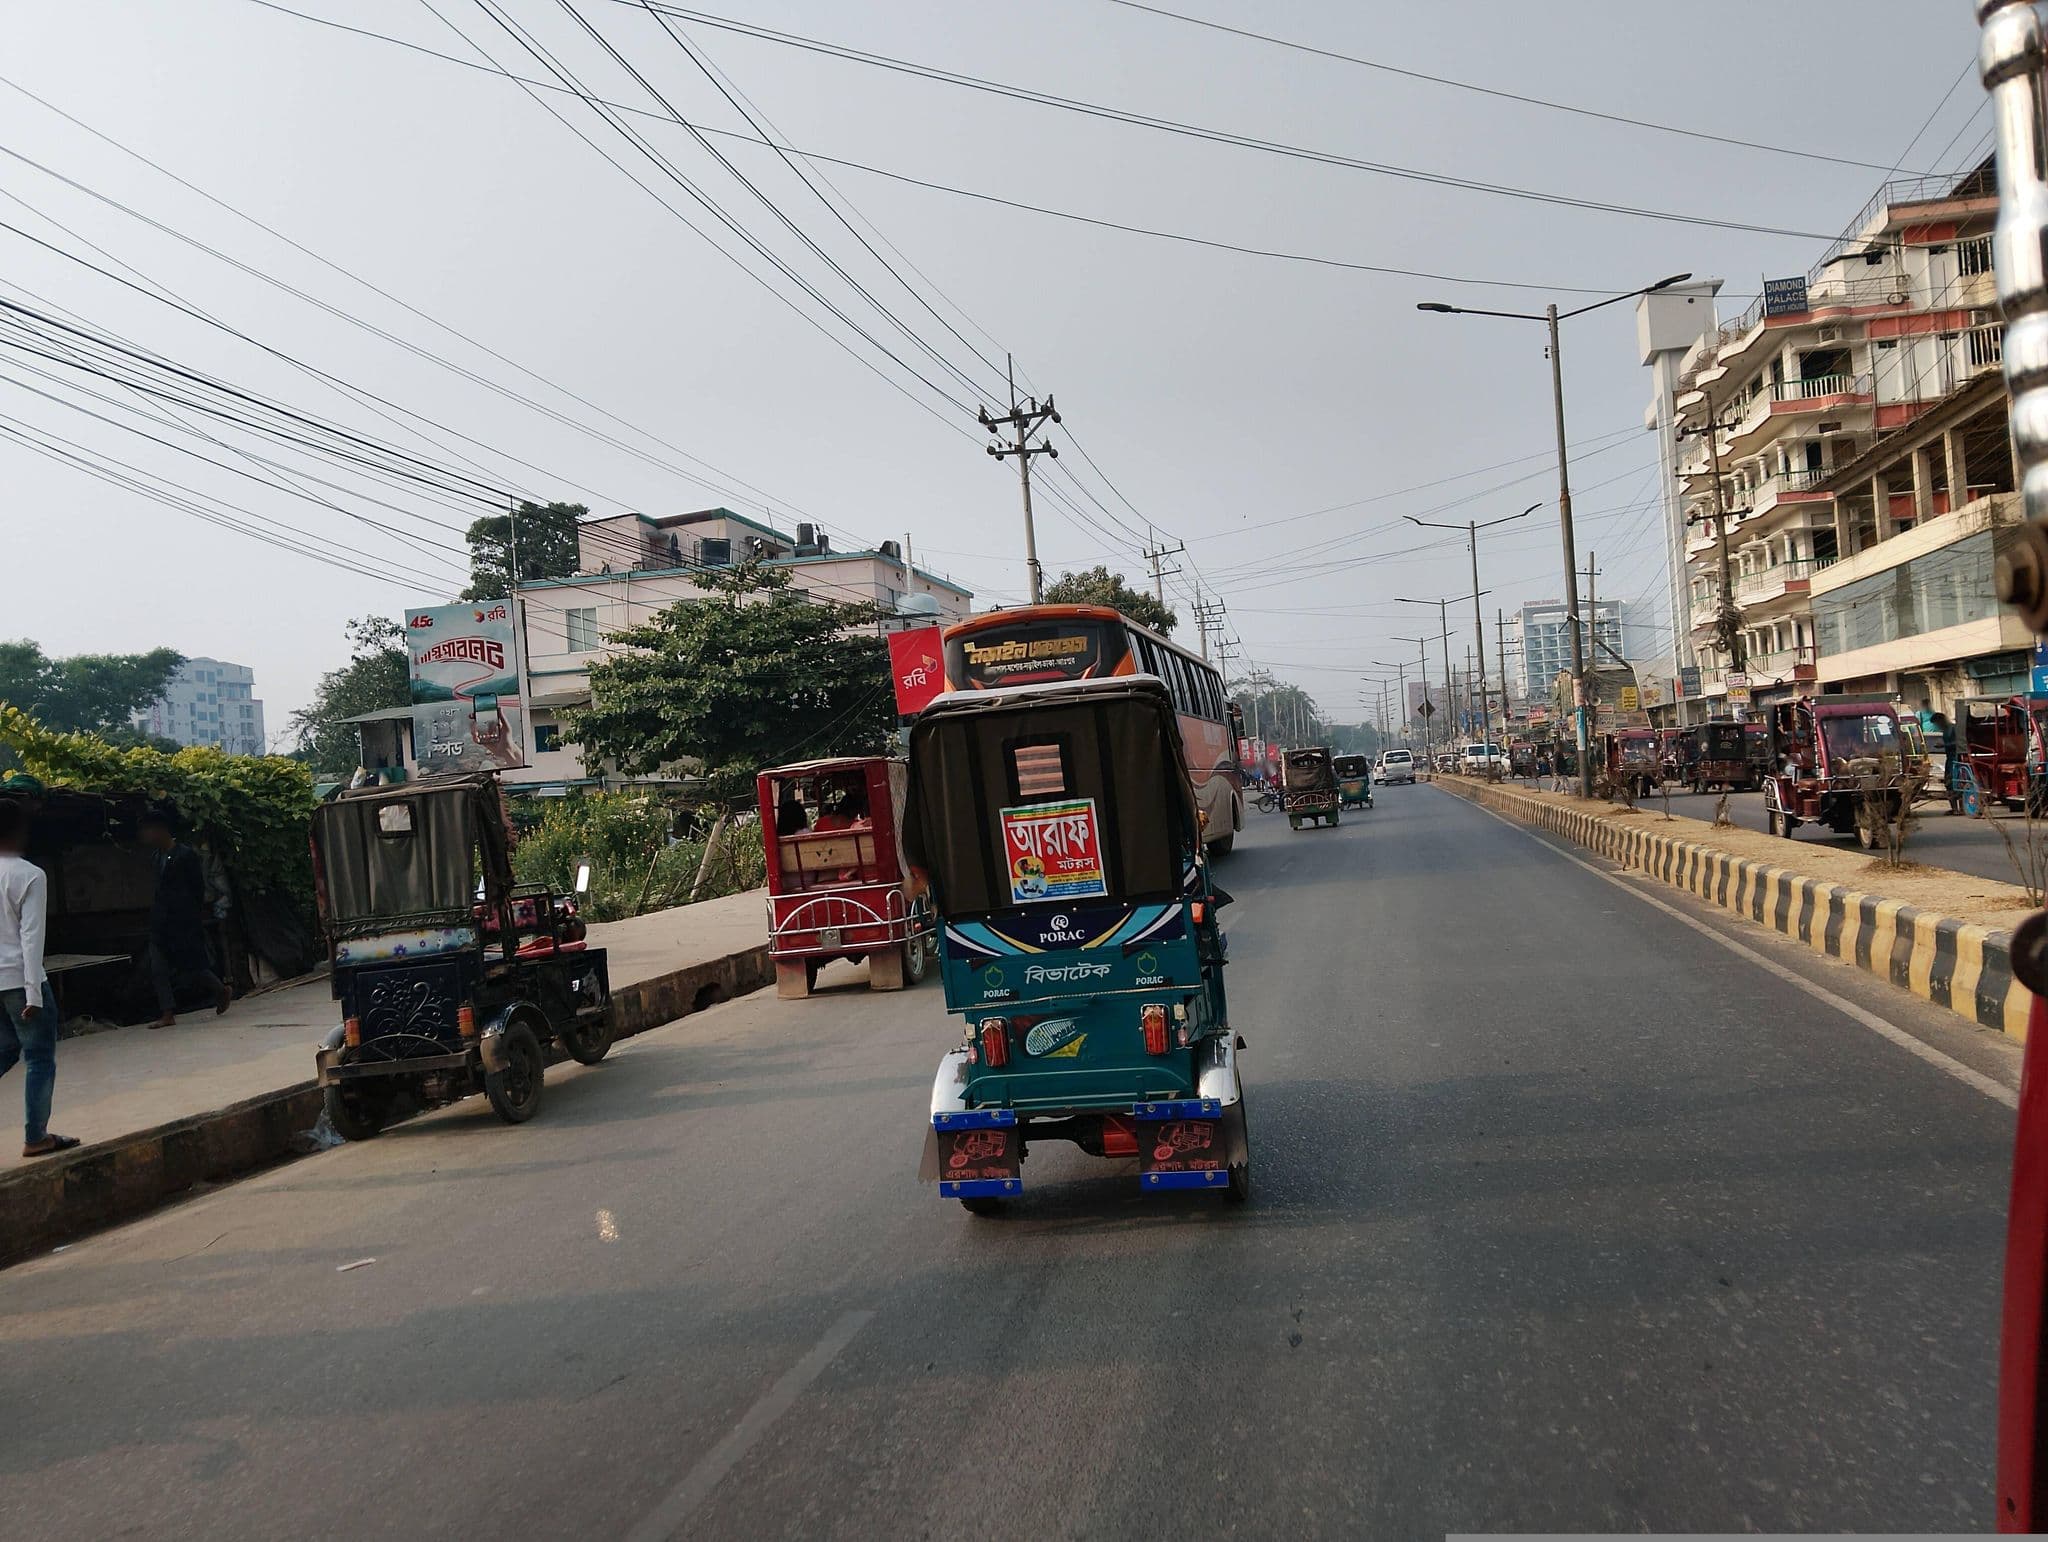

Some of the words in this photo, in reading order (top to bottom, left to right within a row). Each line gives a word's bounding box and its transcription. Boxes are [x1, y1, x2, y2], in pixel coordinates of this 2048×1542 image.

[1766, 279, 1804, 293] DIAMOND
[1767, 291, 1806, 304] PALACE
[1768, 305, 1786, 313] GUEST
[487, 605, 506, 622] রবি
[901, 667, 927, 689] রবি
[1008, 814, 1089, 858] আরাফ
[1039, 929, 1086, 943] PORAC
[1024, 961, 1112, 985] বিভাটেক
[1135, 975, 1164, 986] PORAC
[983, 988, 1011, 999] PORAC
